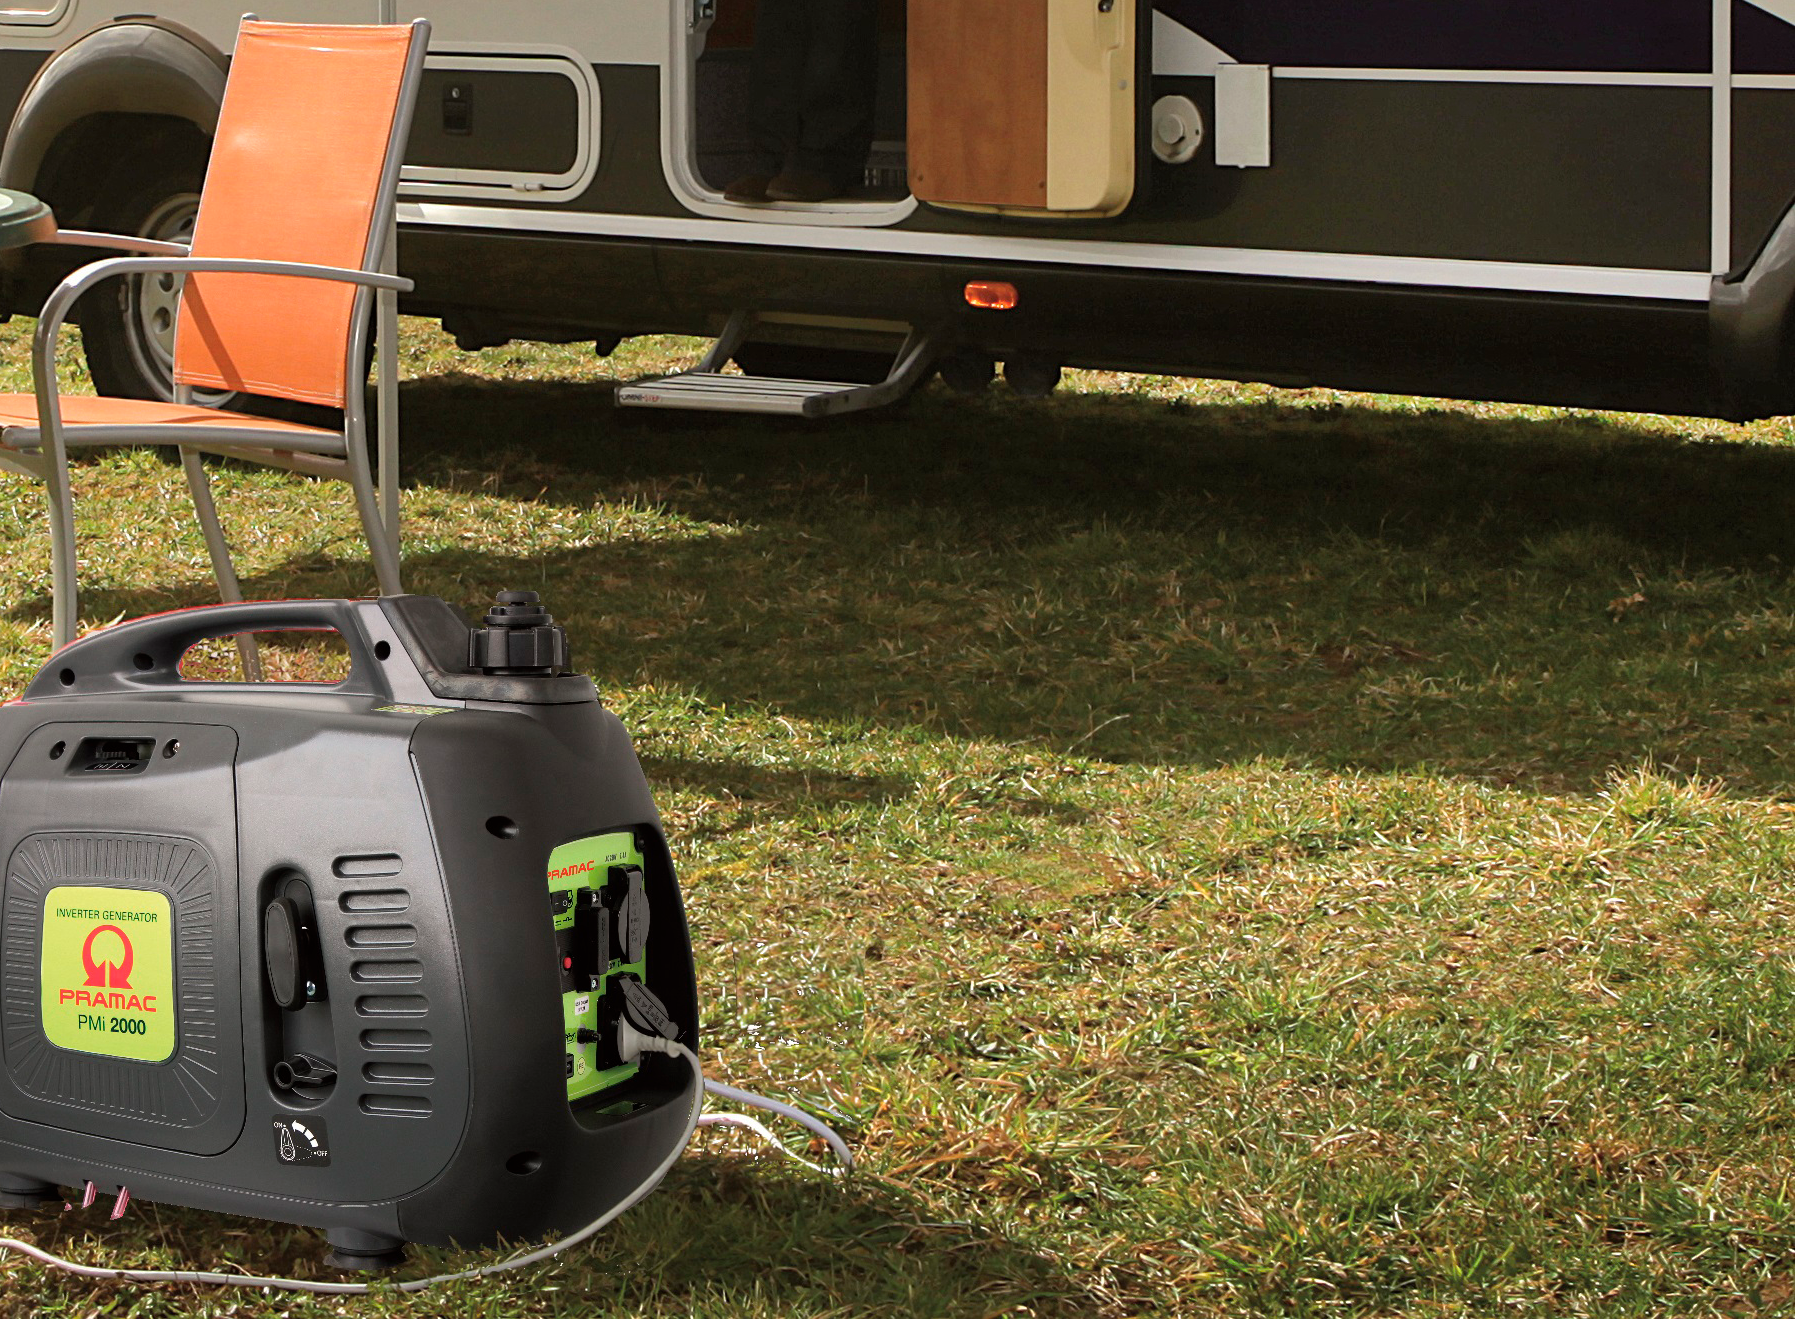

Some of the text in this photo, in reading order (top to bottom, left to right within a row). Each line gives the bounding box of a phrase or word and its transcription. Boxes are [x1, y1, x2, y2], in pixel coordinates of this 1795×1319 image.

[56, 908, 158, 923] INVERTER GENERATOR
[59, 989, 157, 1013] PRAMAC
[78, 1014, 147, 1036] PMi 2000
[273, 1121, 283, 1129] ON
